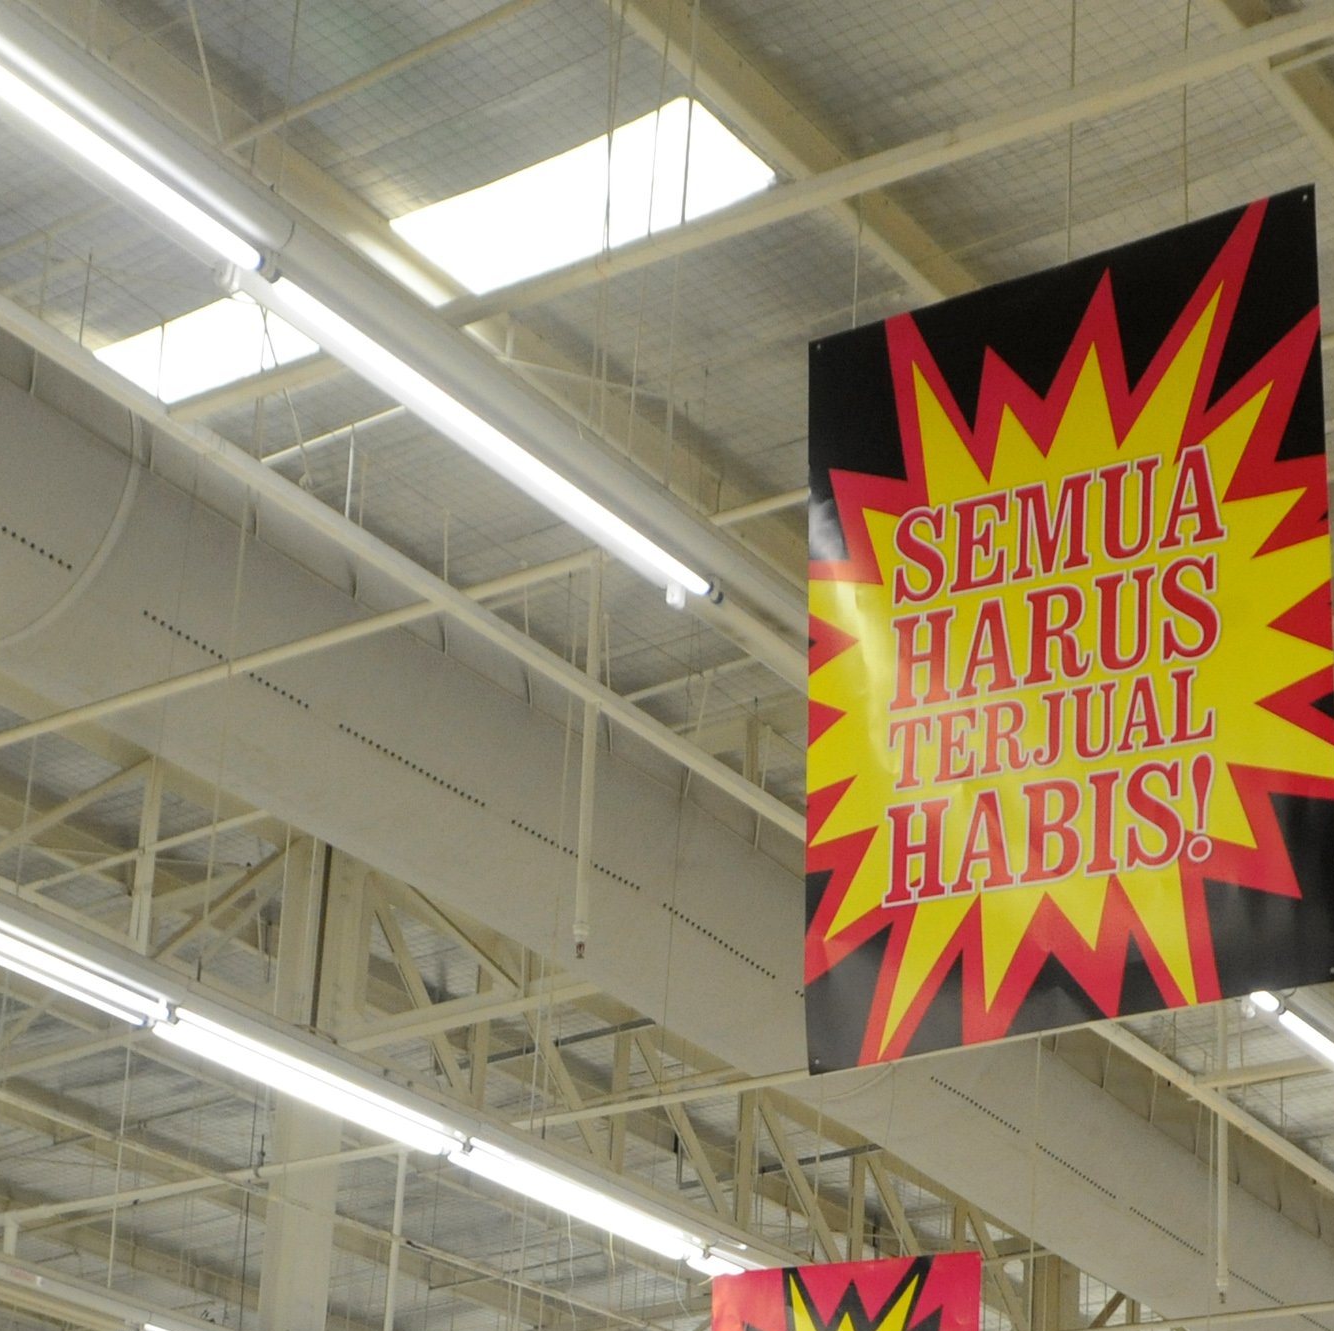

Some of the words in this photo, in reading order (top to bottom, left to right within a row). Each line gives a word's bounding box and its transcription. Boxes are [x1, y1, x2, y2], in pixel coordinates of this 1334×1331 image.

[892, 445, 1225, 606] SEMUA
[889, 554, 1219, 712] HARUS
[888, 668, 1214, 790] TERJUAL
[882, 755, 1213, 909] HABIS!
